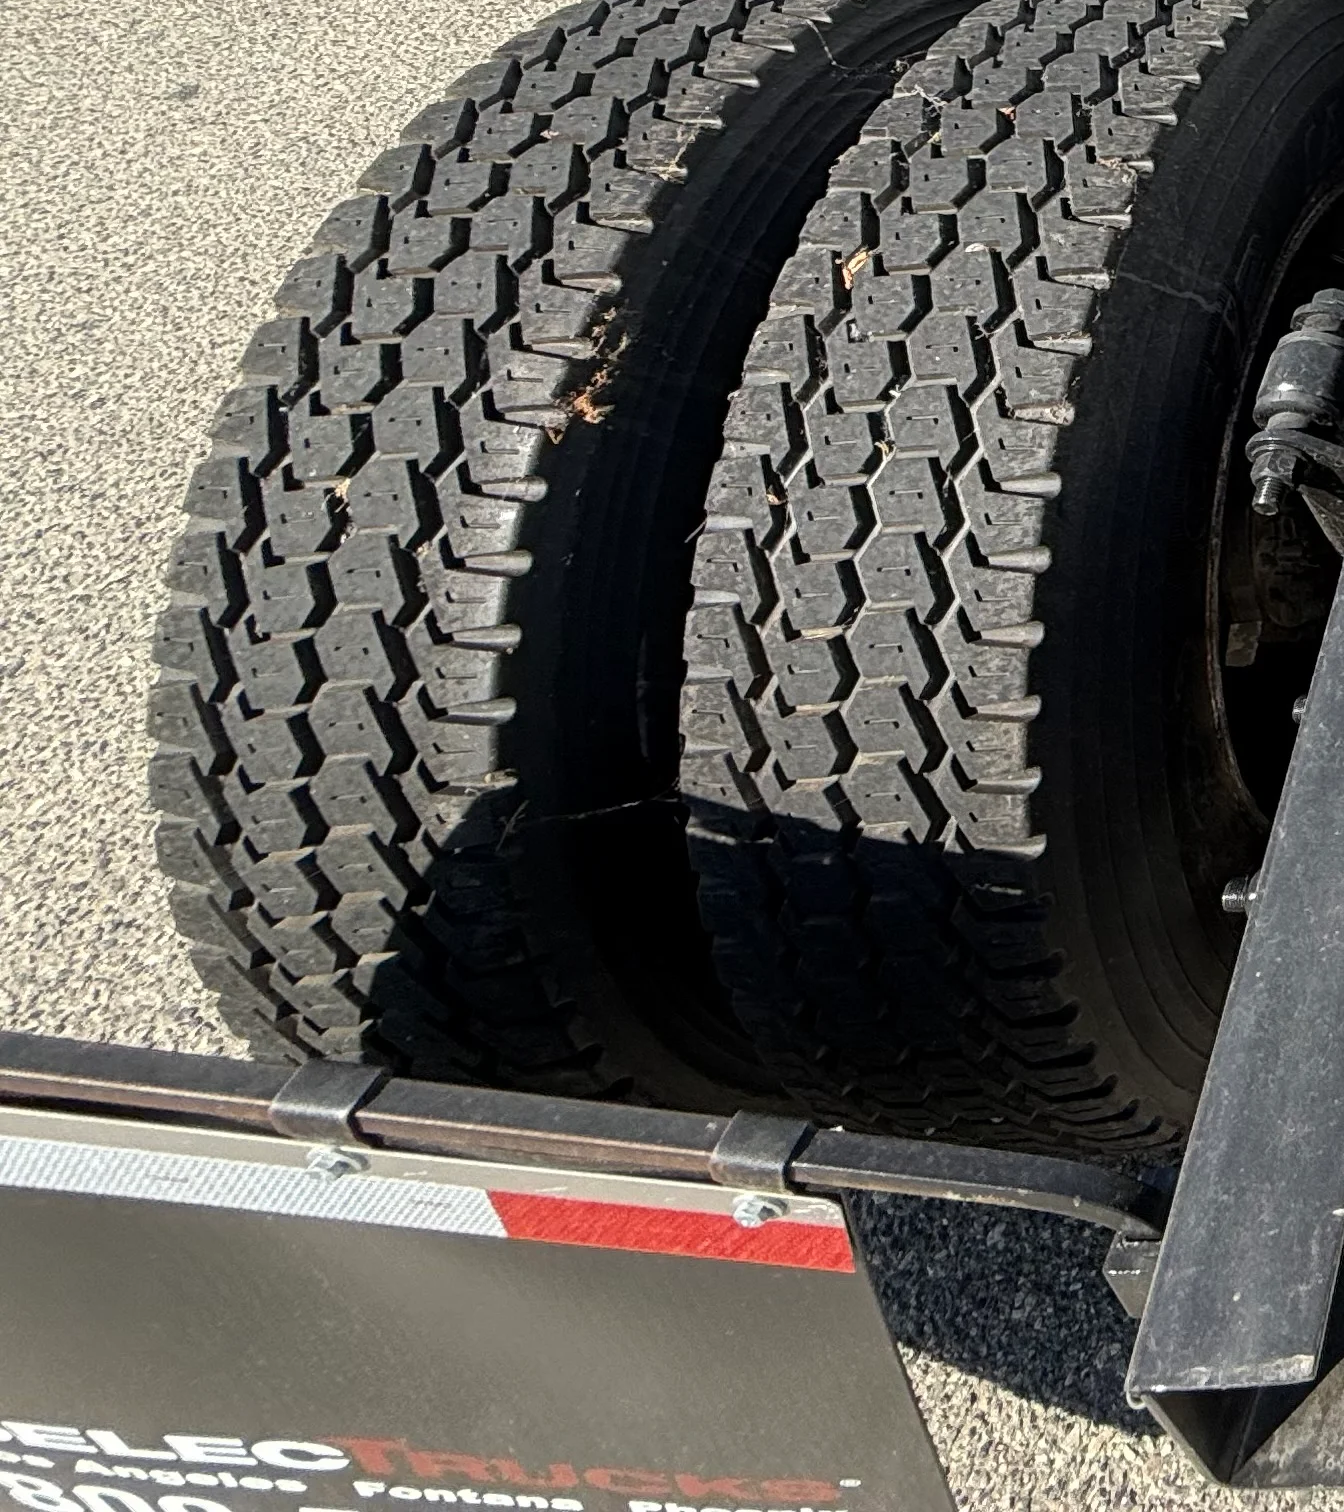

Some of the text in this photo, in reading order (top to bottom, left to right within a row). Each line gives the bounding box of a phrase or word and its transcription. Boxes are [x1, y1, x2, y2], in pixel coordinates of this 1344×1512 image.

[0, 1420, 843, 1504] ELECTRUCKS
[74, 1458, 308, 1491] Angeles
[352, 1480, 584, 1512] Fontana
